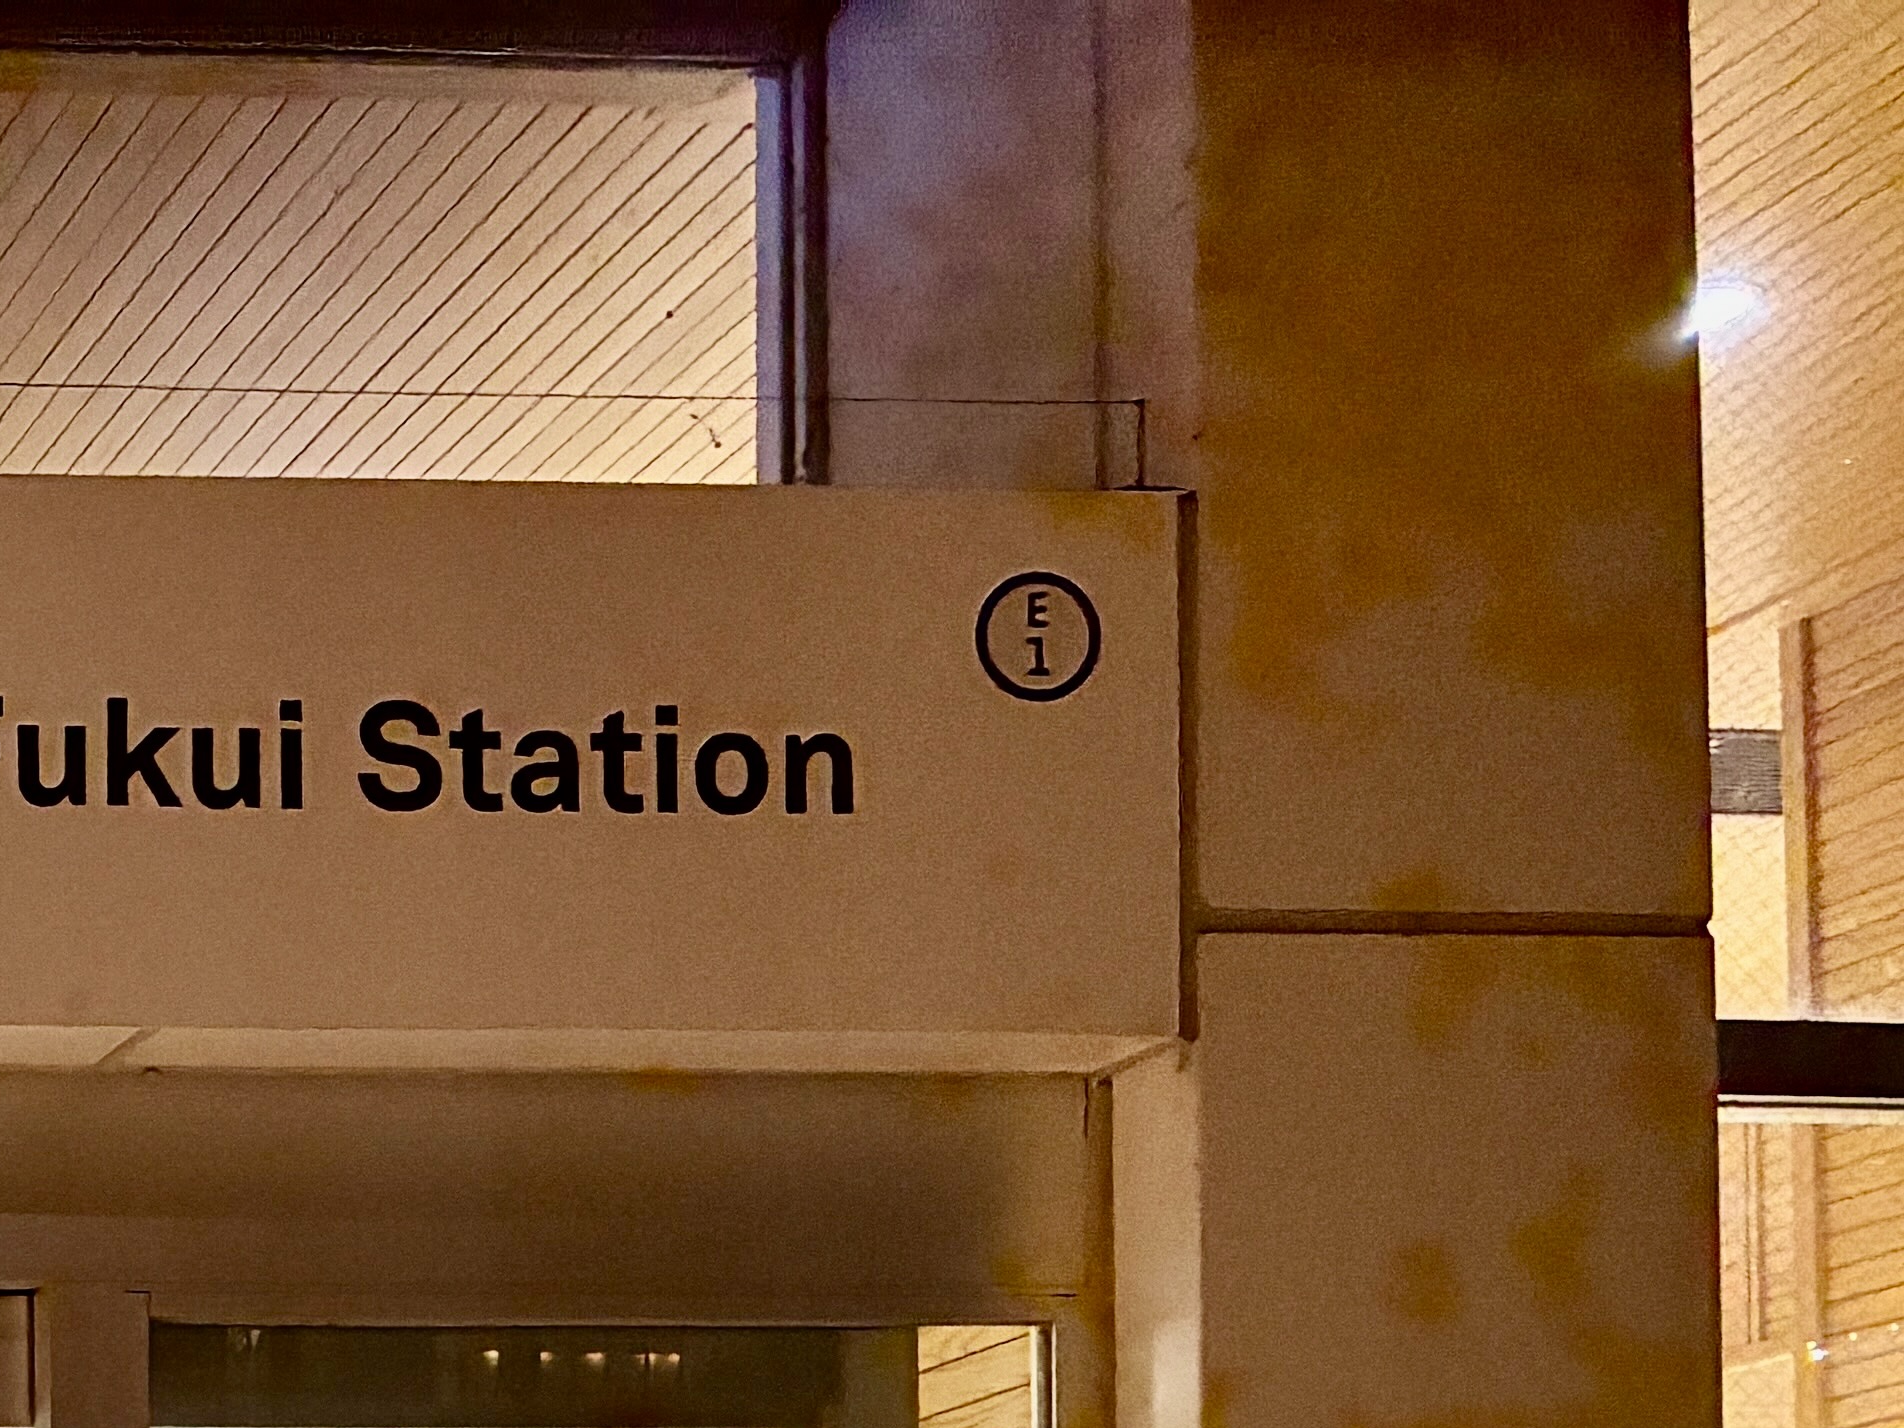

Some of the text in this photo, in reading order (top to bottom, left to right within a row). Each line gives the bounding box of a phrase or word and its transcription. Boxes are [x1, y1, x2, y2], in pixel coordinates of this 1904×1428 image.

[1026, 590, 1050, 628] E
[1025, 635, 1051, 677] 1
[357, 700, 854, 816] Station
